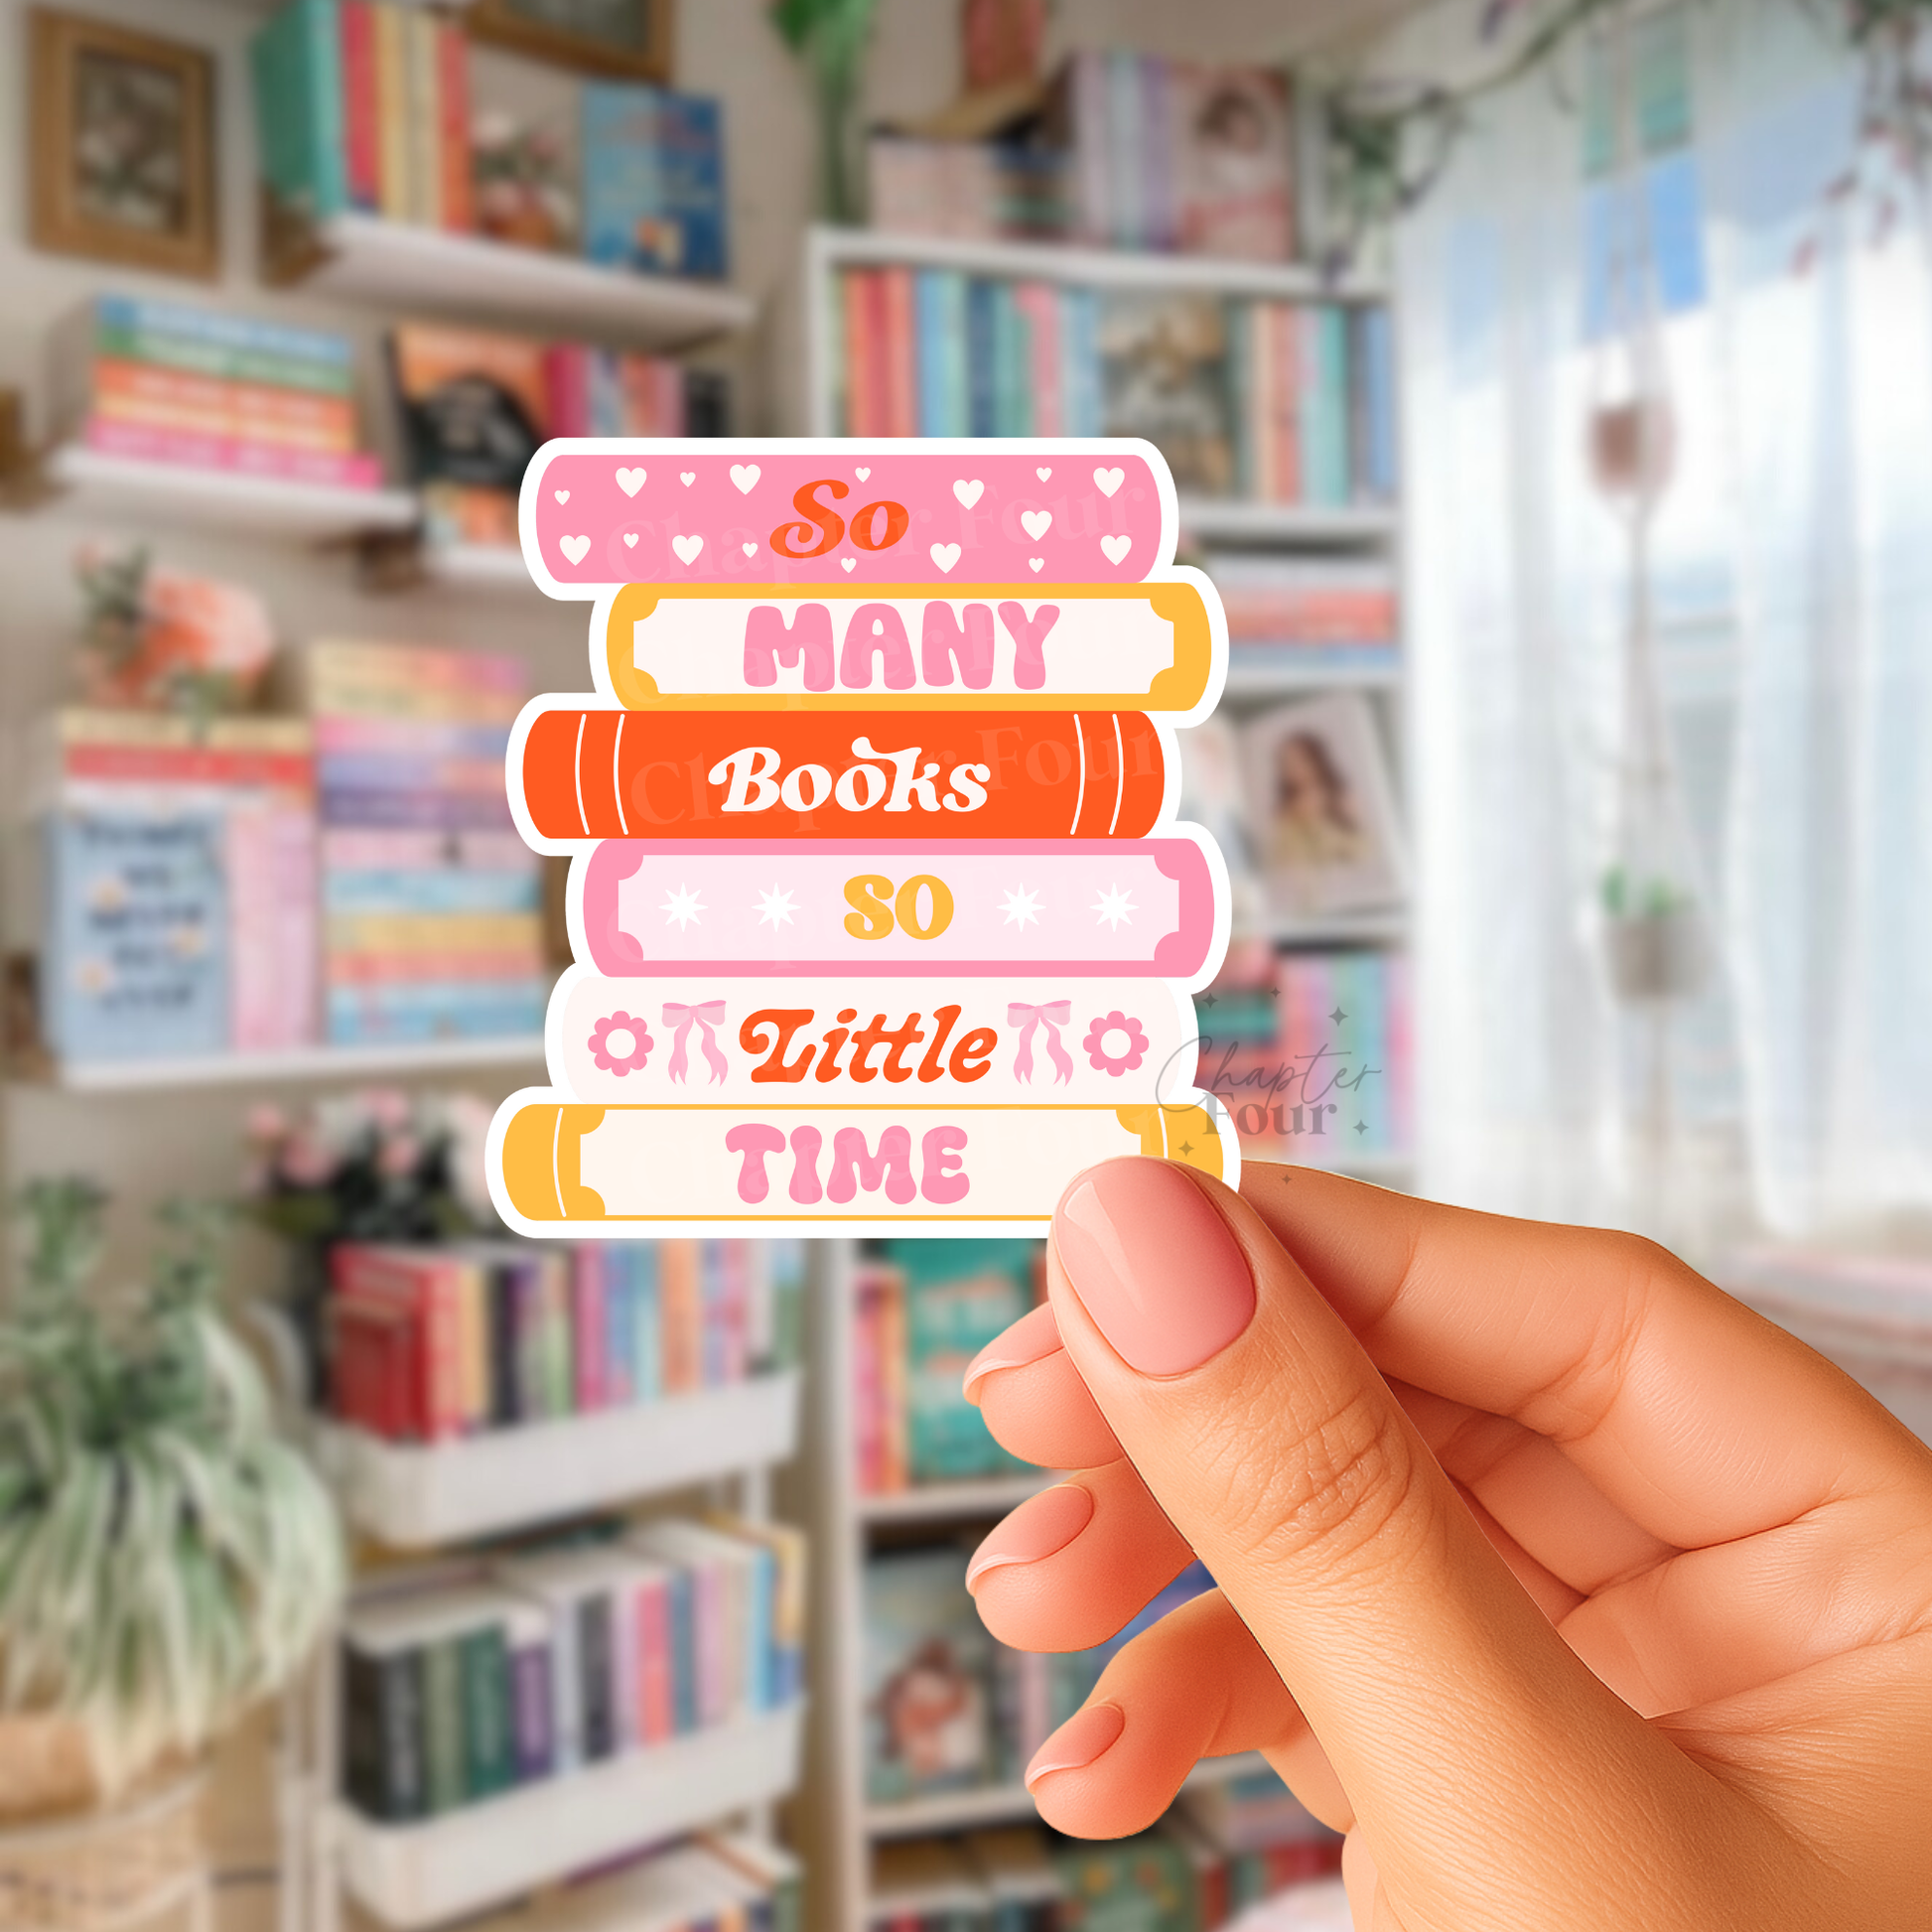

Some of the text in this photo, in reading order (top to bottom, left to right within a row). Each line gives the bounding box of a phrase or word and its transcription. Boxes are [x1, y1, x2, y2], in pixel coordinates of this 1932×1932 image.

[770, 479, 909, 559] So
[743, 600, 1060, 693] MANY
[708, 737, 991, 813] Books
[739, 1004, 998, 1083] Little
[725, 1123, 970, 1205] TIME
